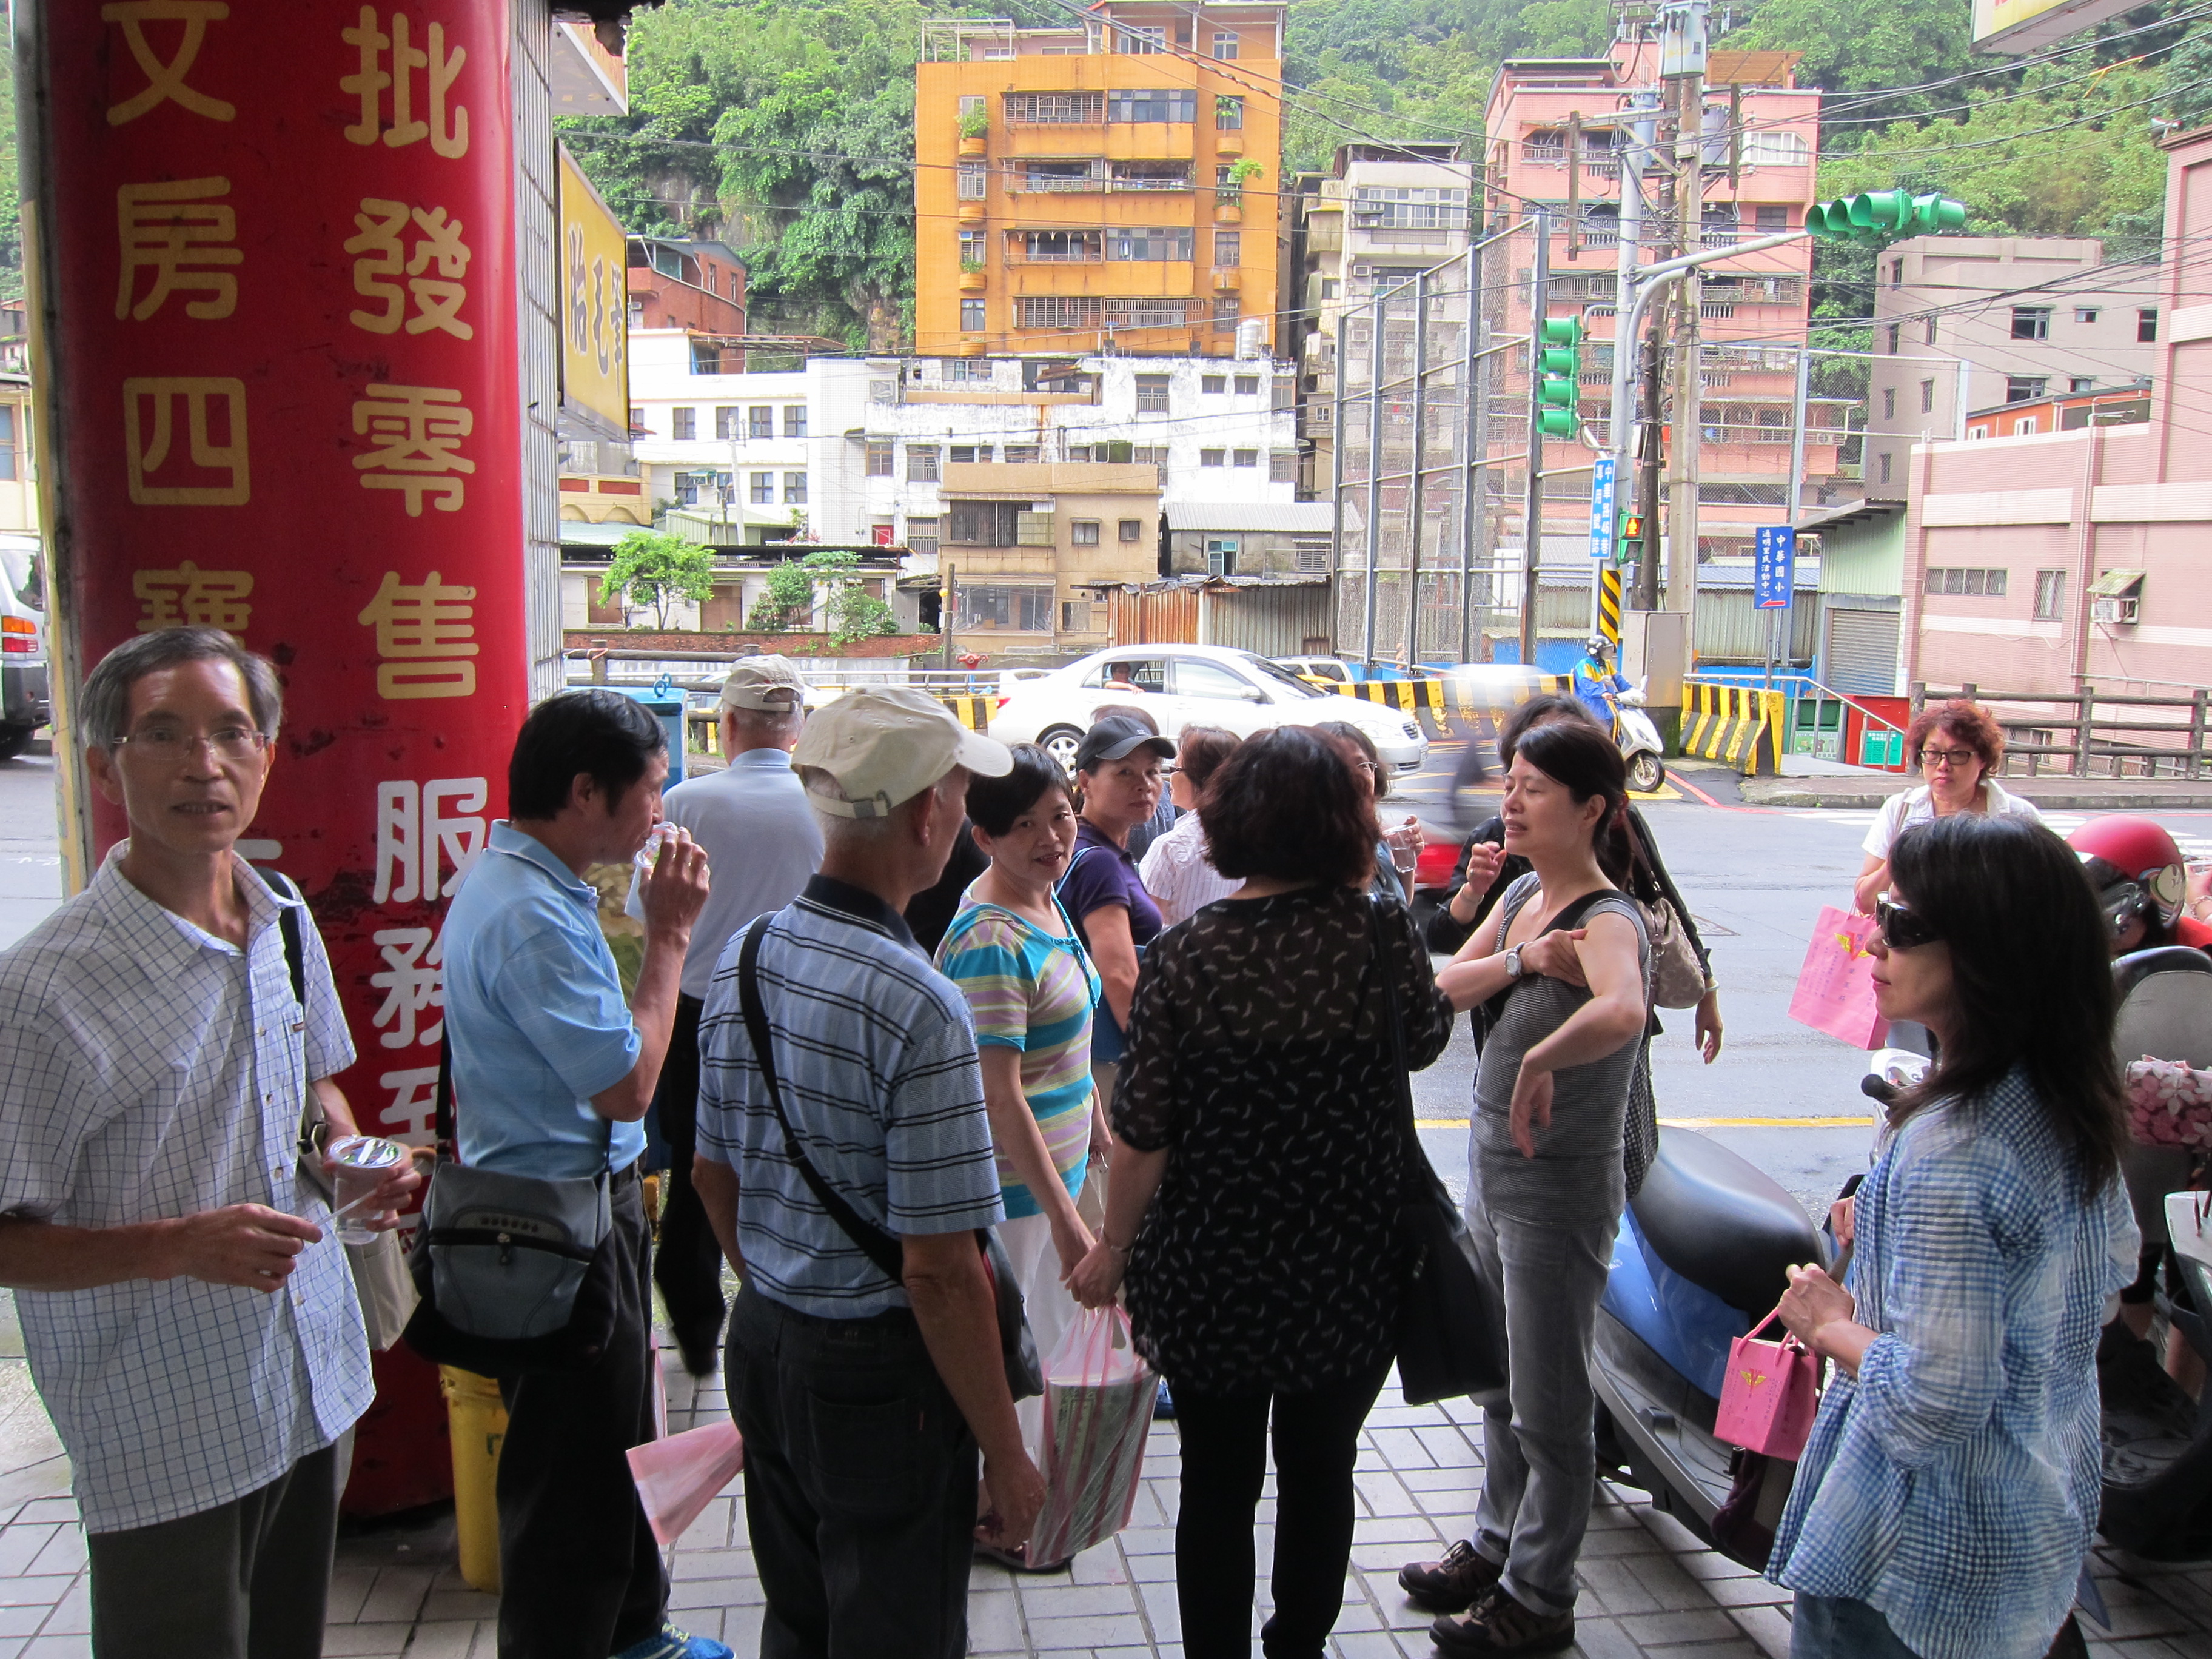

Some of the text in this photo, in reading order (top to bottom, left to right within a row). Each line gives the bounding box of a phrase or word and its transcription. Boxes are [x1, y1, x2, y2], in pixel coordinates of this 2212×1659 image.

[340, 6, 479, 699] 批發零售
[568, 223, 623, 397] 胎毛筆
[1760, 529, 1771, 597] 通明里民活動中心
[1775, 534, 1786, 592] 中華國小
